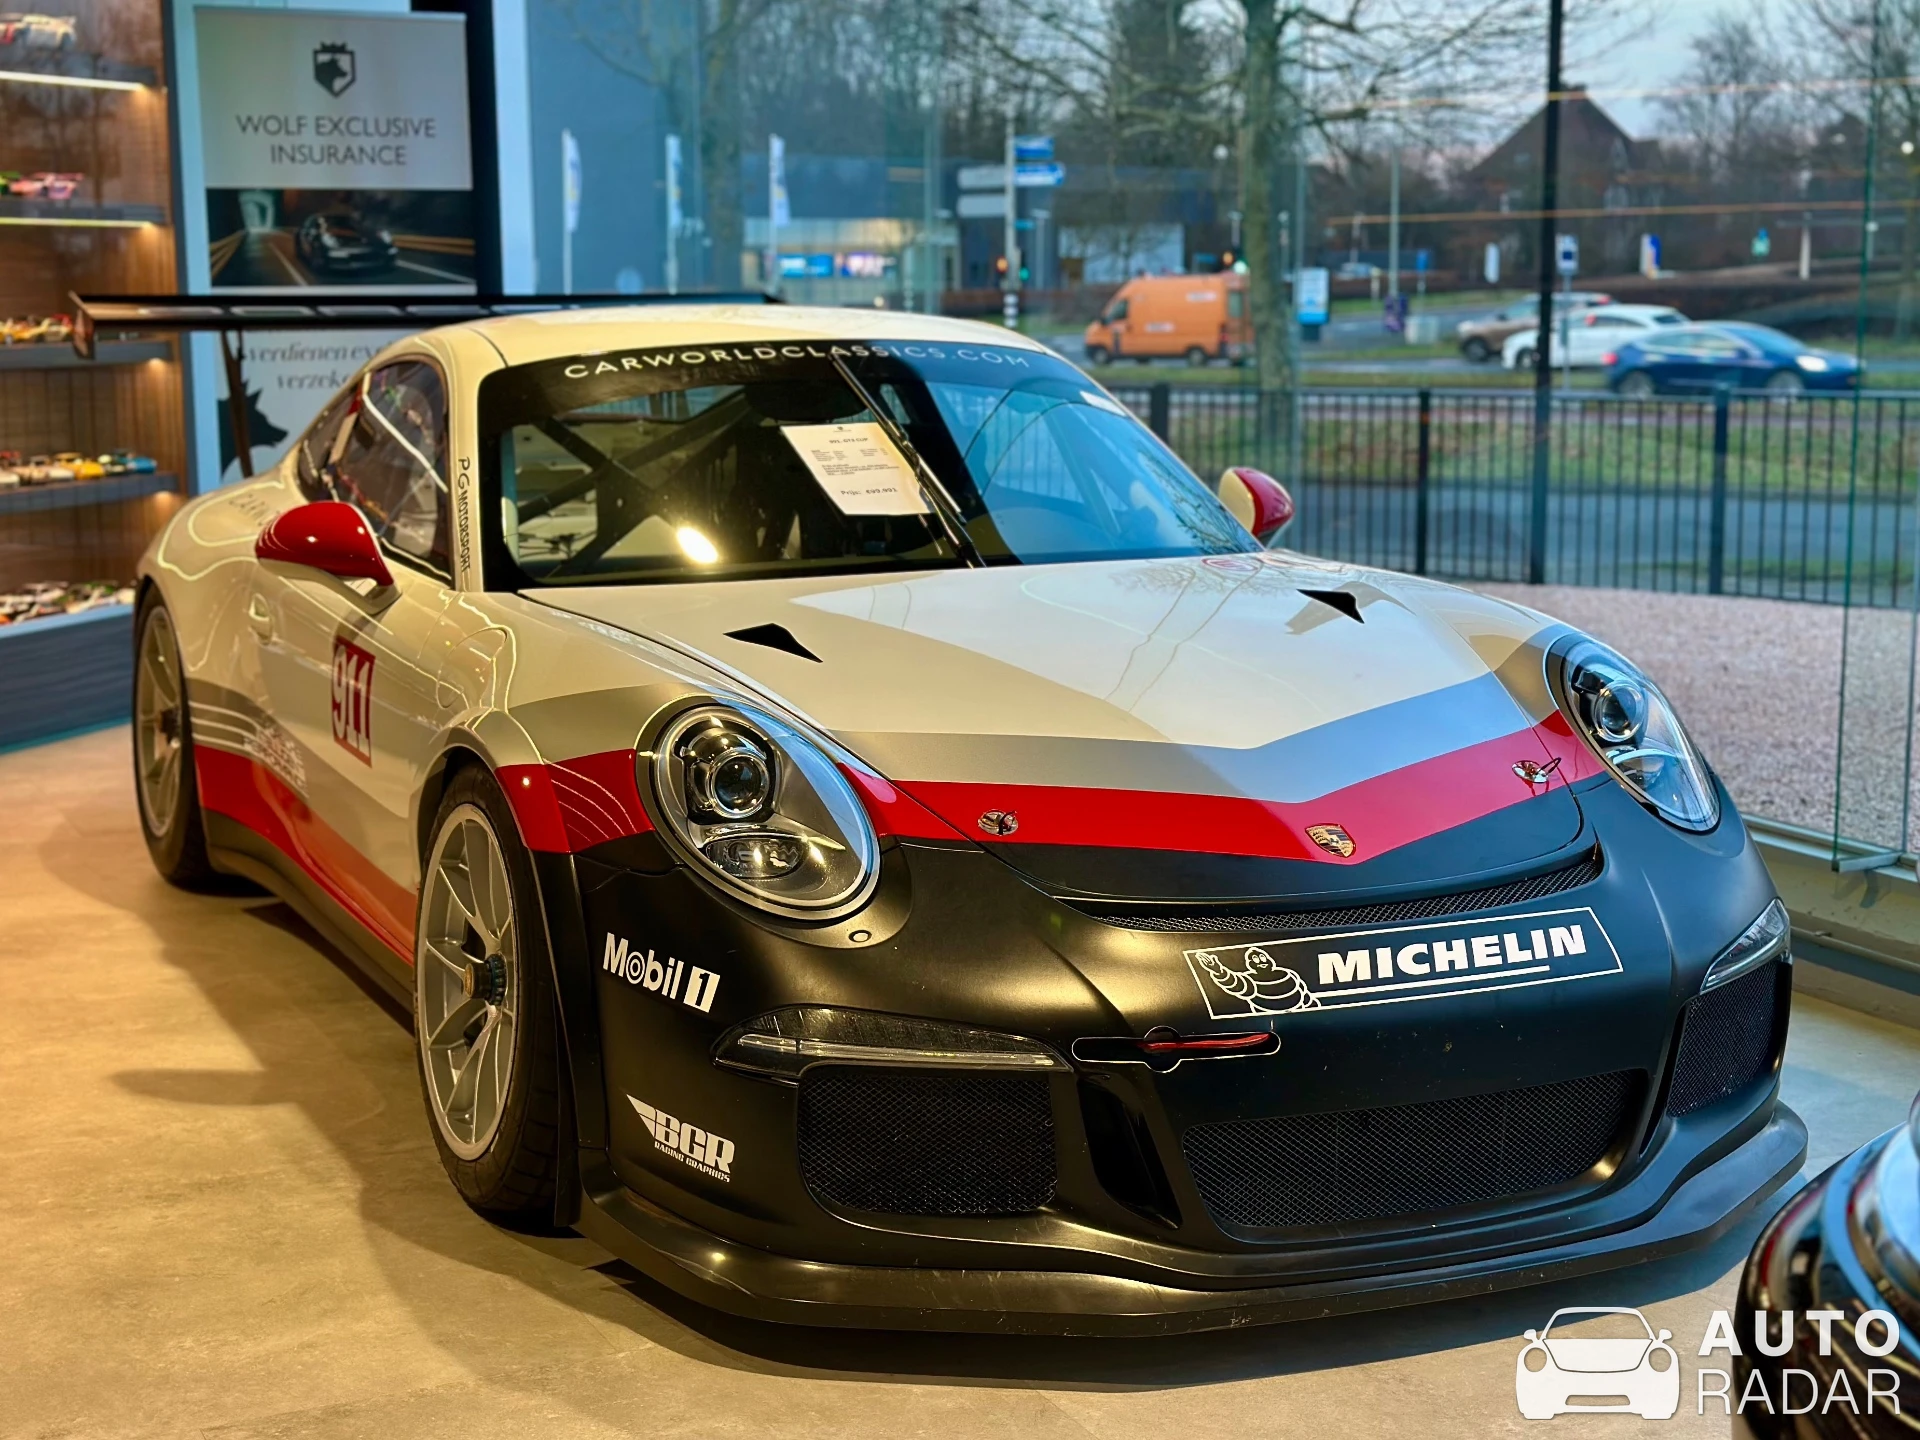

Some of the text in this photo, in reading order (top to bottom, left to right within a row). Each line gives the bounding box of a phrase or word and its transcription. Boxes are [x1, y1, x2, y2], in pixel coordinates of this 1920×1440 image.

[235, 115, 436, 138] WOLF EXCLUSIVE
[270, 145, 407, 166] INSURANCE
[249, 341, 349, 362] verdienen
[564, 345, 1030, 379] CARWORLDCLASSICS.COM
[332, 644, 371, 758] 911
[602, 931, 685, 1000] Mobil
[1317, 924, 1587, 985] MICHELIN
[654, 1108, 735, 1174] BGR
[654, 1140, 731, 1183] RACING GRAPHICS
